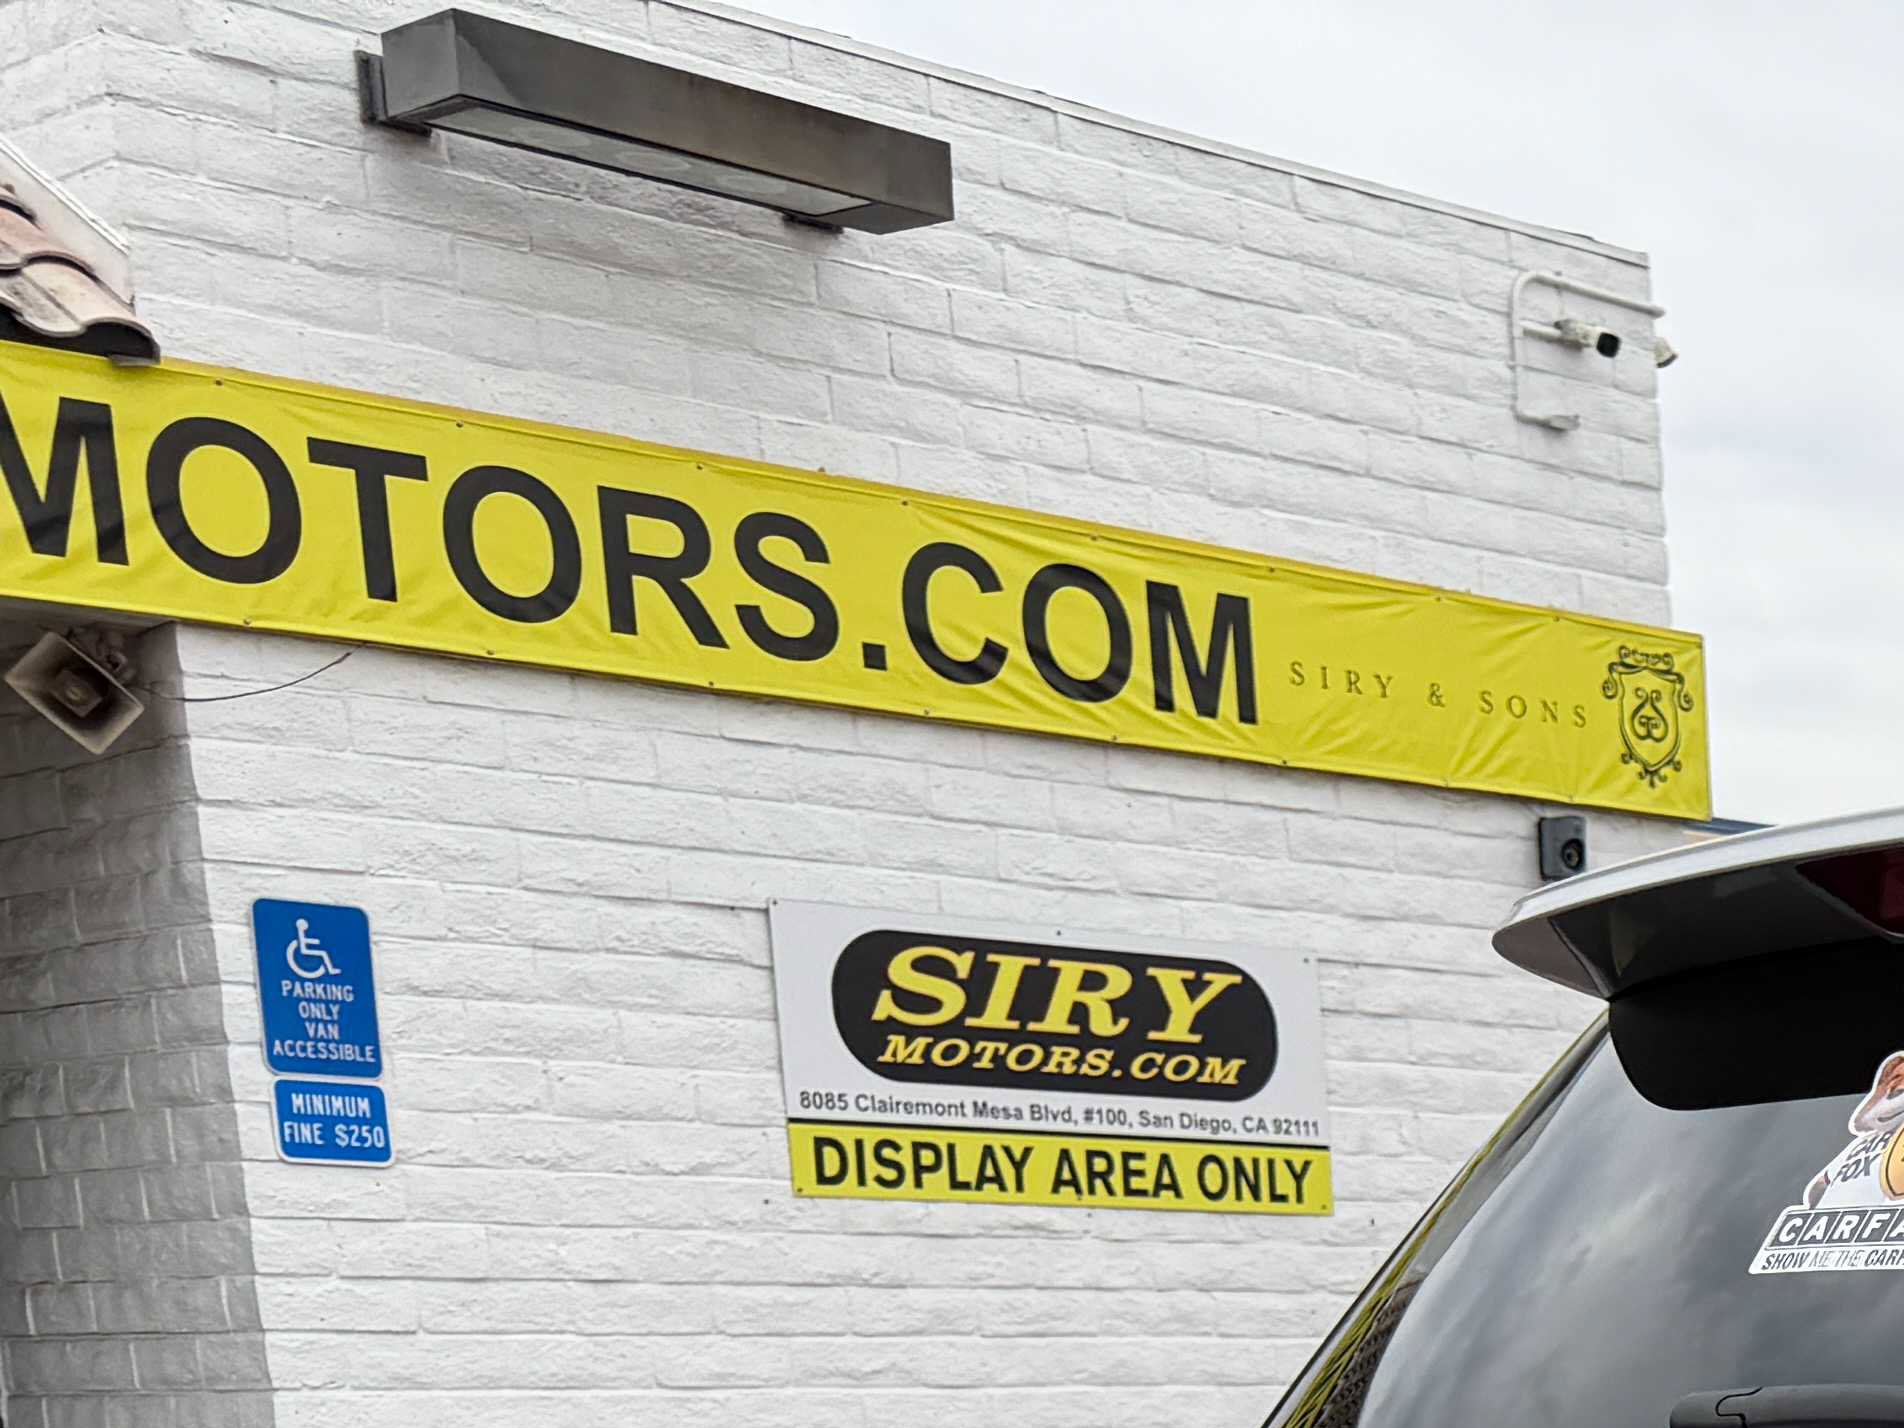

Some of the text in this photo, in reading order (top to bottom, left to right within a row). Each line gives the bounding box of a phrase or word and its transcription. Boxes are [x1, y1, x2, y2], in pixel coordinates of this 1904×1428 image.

[0, 388, 1588, 729] MOTORS.COM SIRY & SONS
[281, 979, 354, 1003] PARKING
[871, 945, 1242, 1044] SIRY
[298, 1001, 341, 1022] ONLY
[305, 1021, 340, 1041] VAN
[272, 1038, 377, 1064] ACCESSIBLE
[877, 1035, 1247, 1086] MOTORS.COM
[290, 1091, 371, 1120] MINIMUM
[799, 1090, 1320, 1137] 8085 Clairemont Mesa Blvd, #100, San Diego, CA 92111
[283, 1121, 385, 1150] FINE $250
[812, 1135, 1313, 1205] DISPLAY AREA ONLY
[1830, 1153, 1881, 1187] FOX
[1761, 1252, 1810, 1271] SHOW
